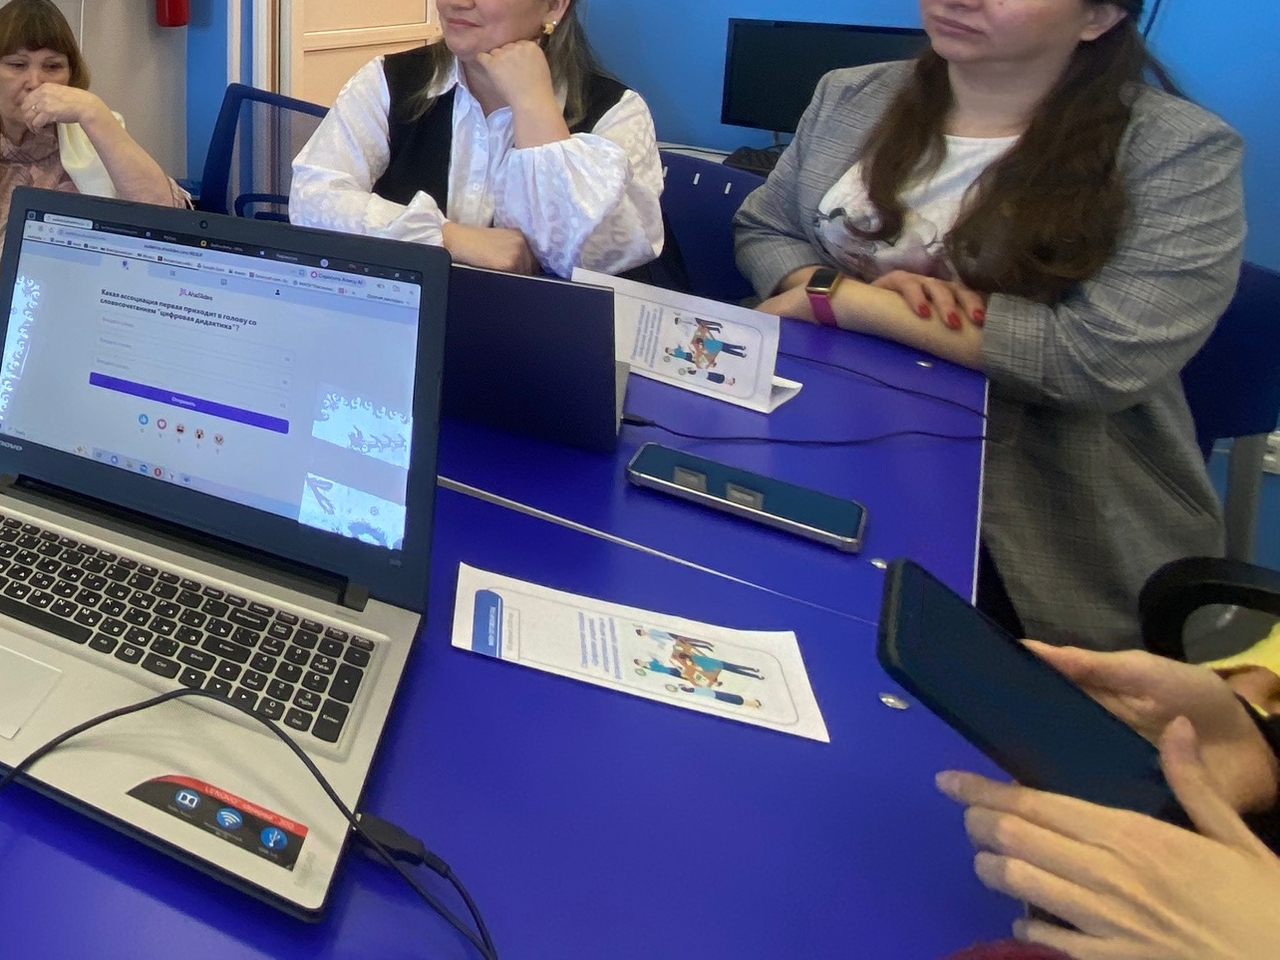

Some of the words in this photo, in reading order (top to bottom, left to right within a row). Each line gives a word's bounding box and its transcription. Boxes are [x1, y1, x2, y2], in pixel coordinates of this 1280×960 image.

[101, 289, 120, 299] Какая
[120, 293, 158, 306] ассоциация
[159, 300, 183, 312] первая
[183, 306, 217, 319] приходит
[222, 314, 248, 326] голову
[188, 291, 213, 301] AhaSlides
[100, 298, 157, 315] словосочетанием
[157, 308, 195, 323] "цифровая
